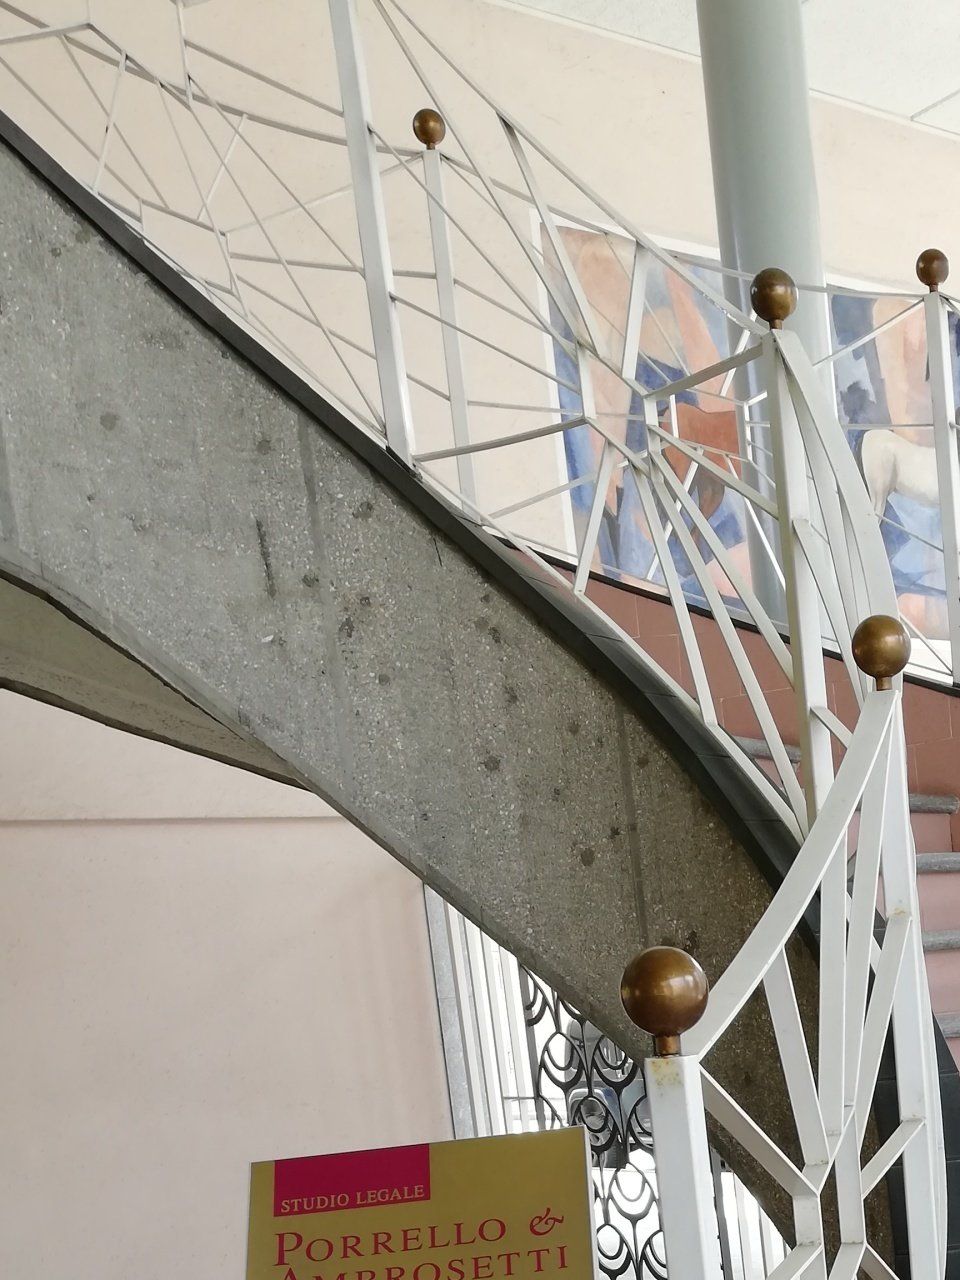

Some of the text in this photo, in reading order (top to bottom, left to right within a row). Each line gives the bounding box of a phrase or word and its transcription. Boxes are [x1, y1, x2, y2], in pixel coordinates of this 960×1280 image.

[281, 1185, 425, 1213] STUDIO LEGALE
[273, 1218, 506, 1266] PORRELLO
